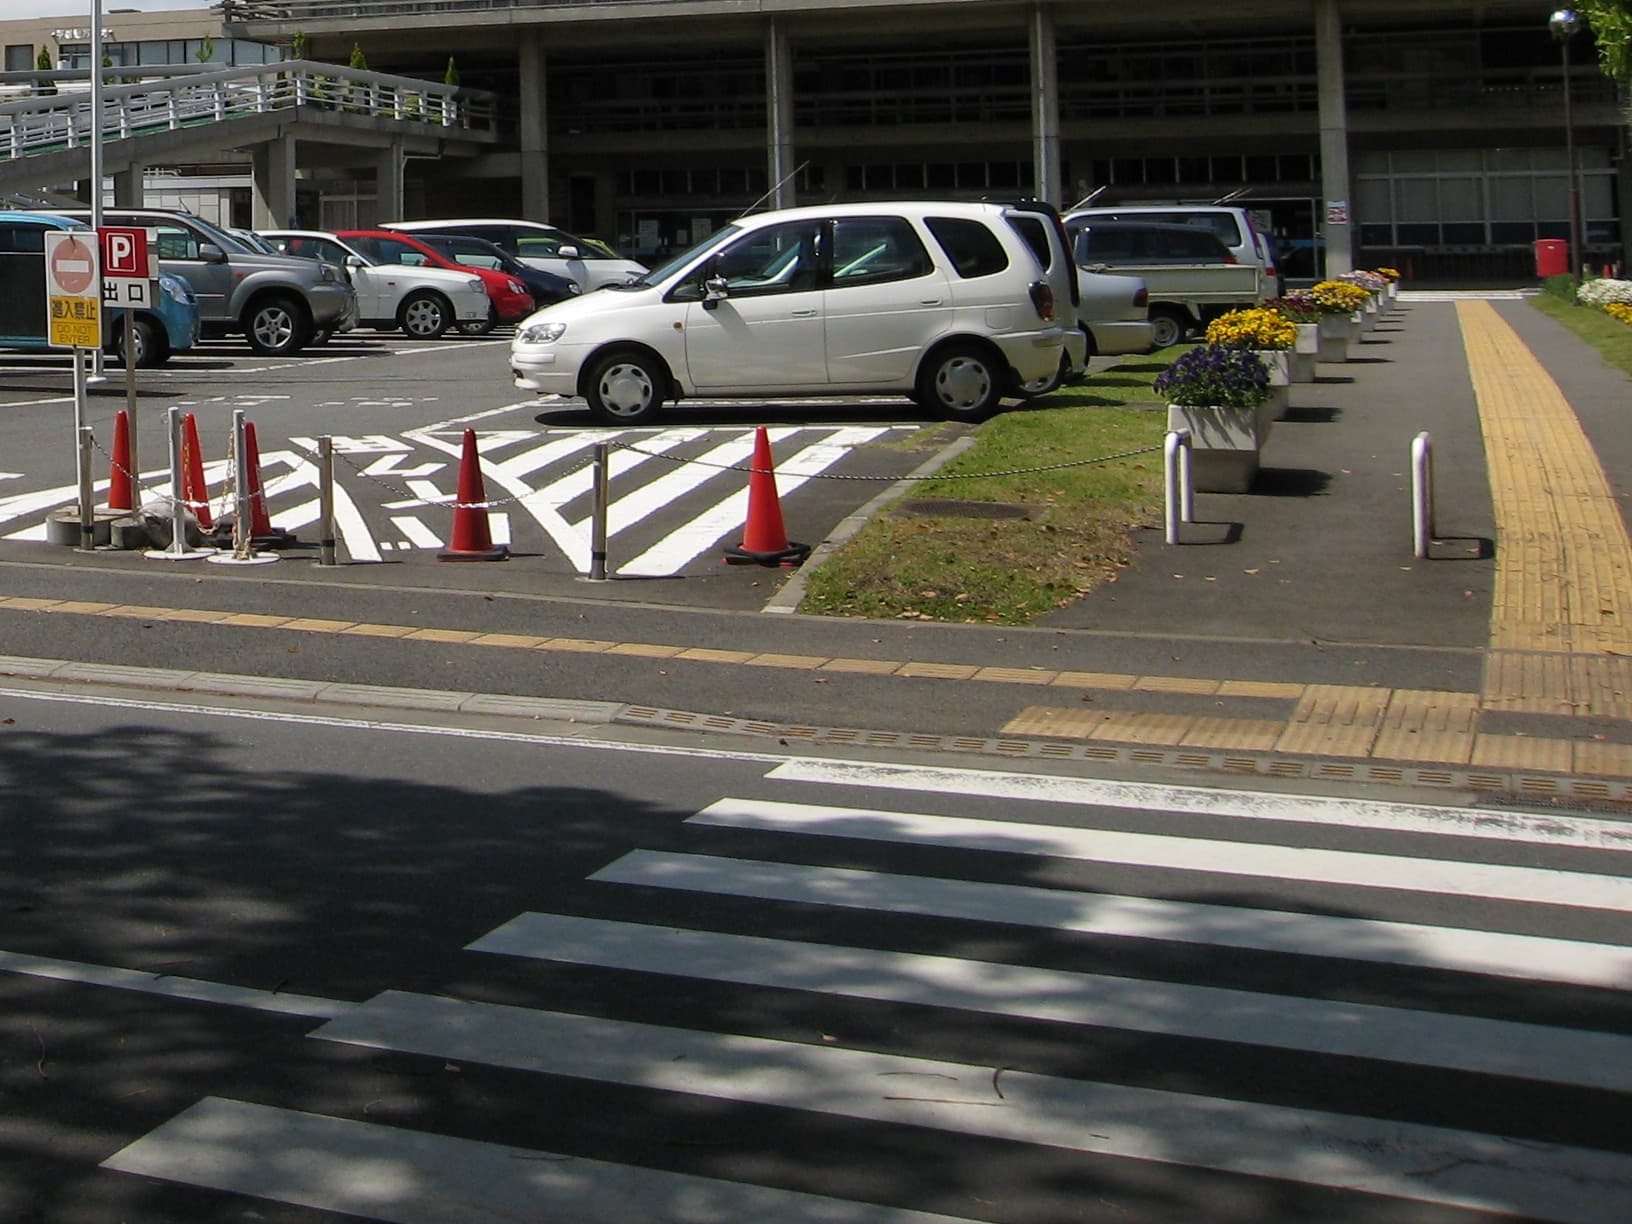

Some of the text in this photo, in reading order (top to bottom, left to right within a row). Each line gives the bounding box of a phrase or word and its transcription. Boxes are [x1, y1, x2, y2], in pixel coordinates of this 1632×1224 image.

[111, 236, 131, 268] P
[104, 281, 144, 303] 出口
[52, 300, 97, 320] 進入禁止
[57, 324, 92, 334] DO NOT
[59, 334, 90, 344] ENTER
